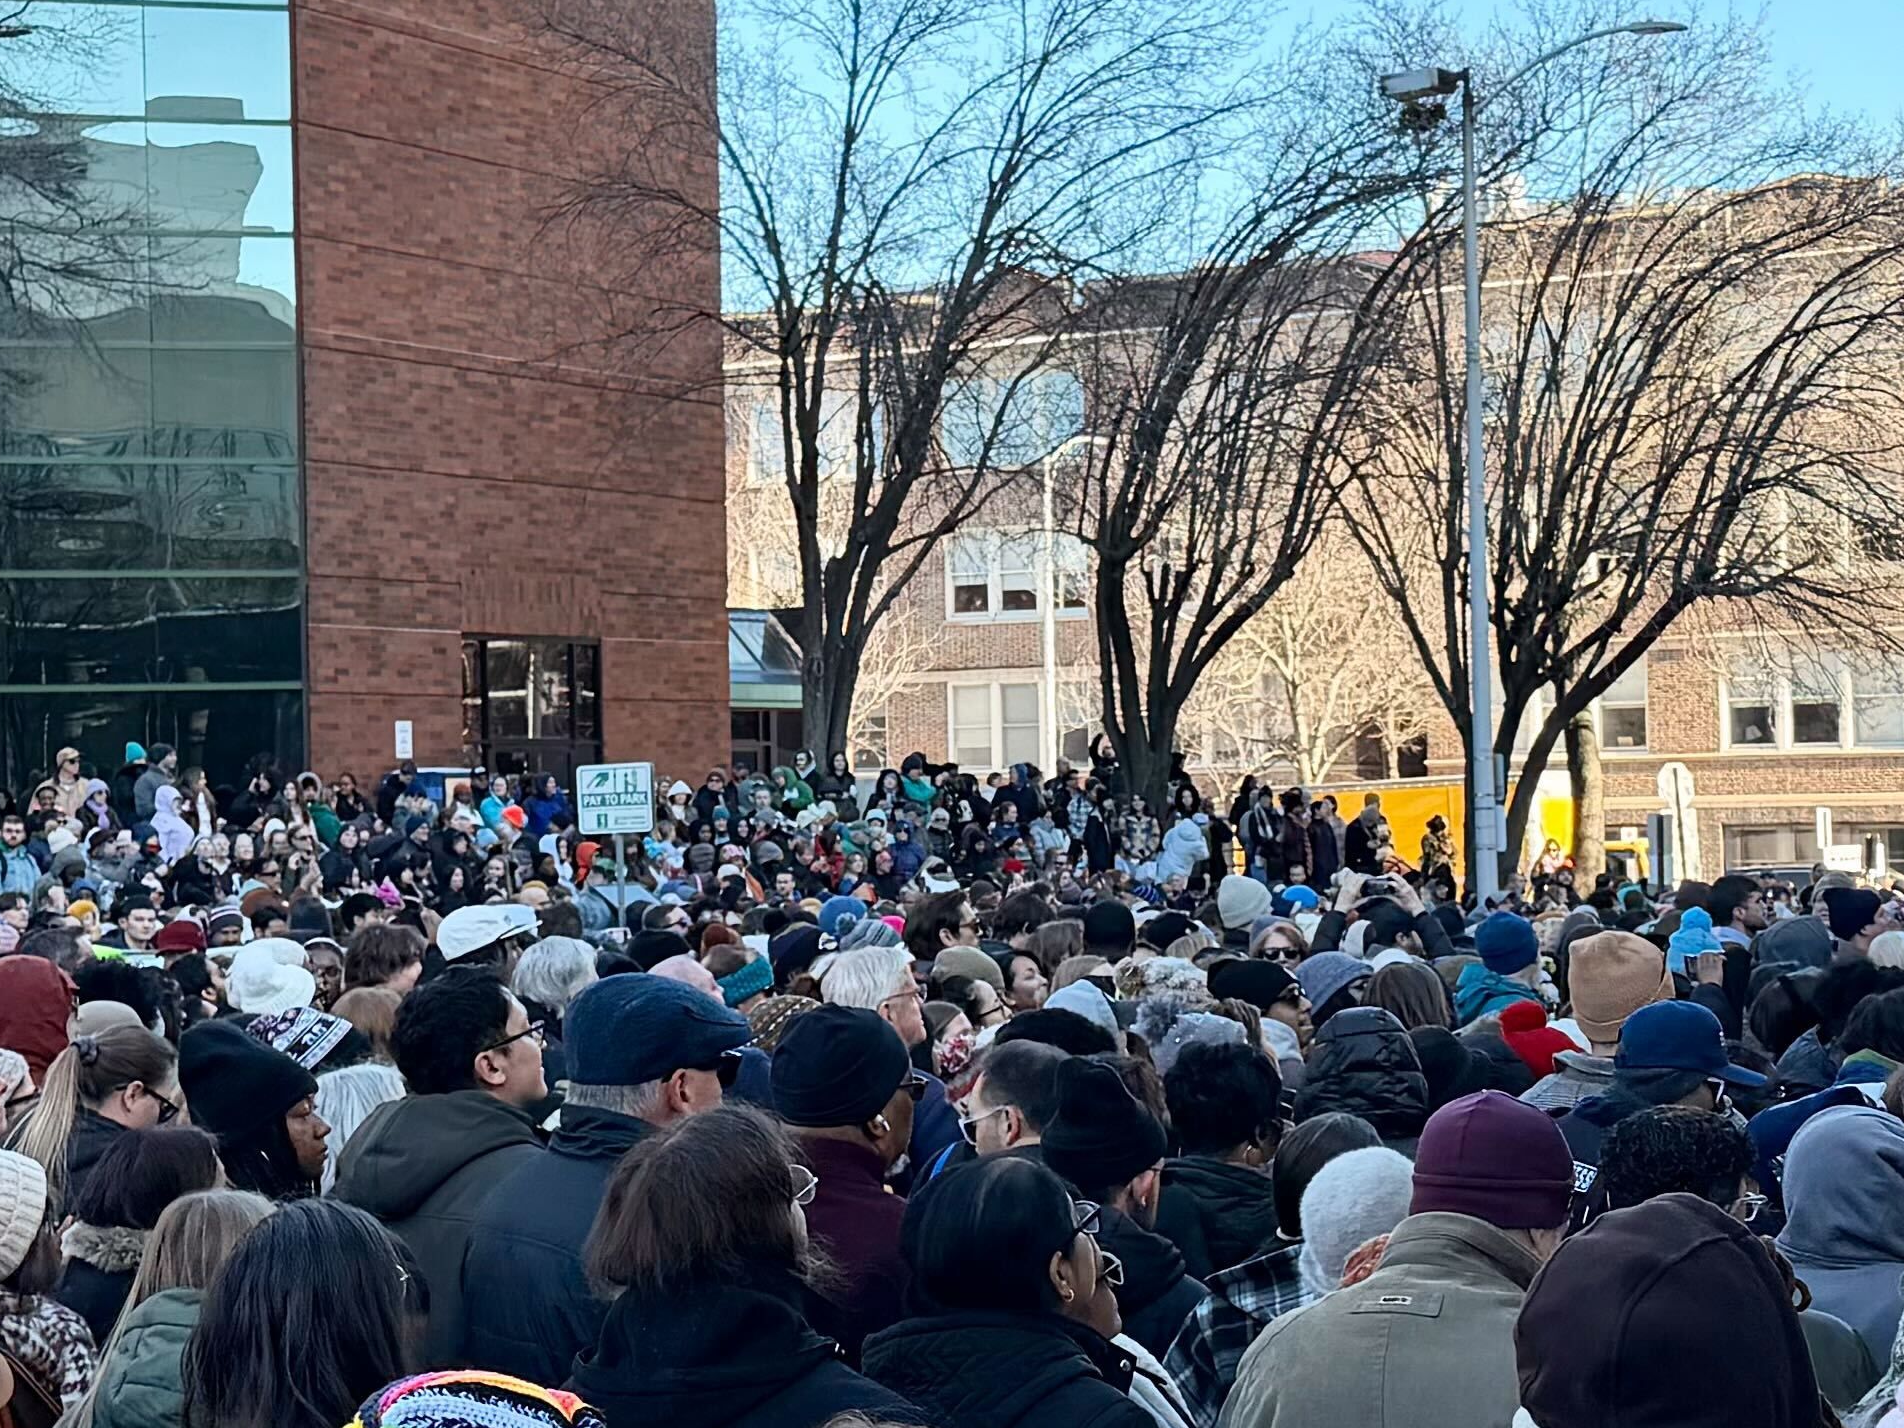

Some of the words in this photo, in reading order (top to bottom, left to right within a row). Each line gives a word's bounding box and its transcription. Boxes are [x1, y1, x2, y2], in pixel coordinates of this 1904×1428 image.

[583, 795, 602, 807] PAY
[605, 794, 618, 806] TO
[620, 793, 647, 805] PARK
